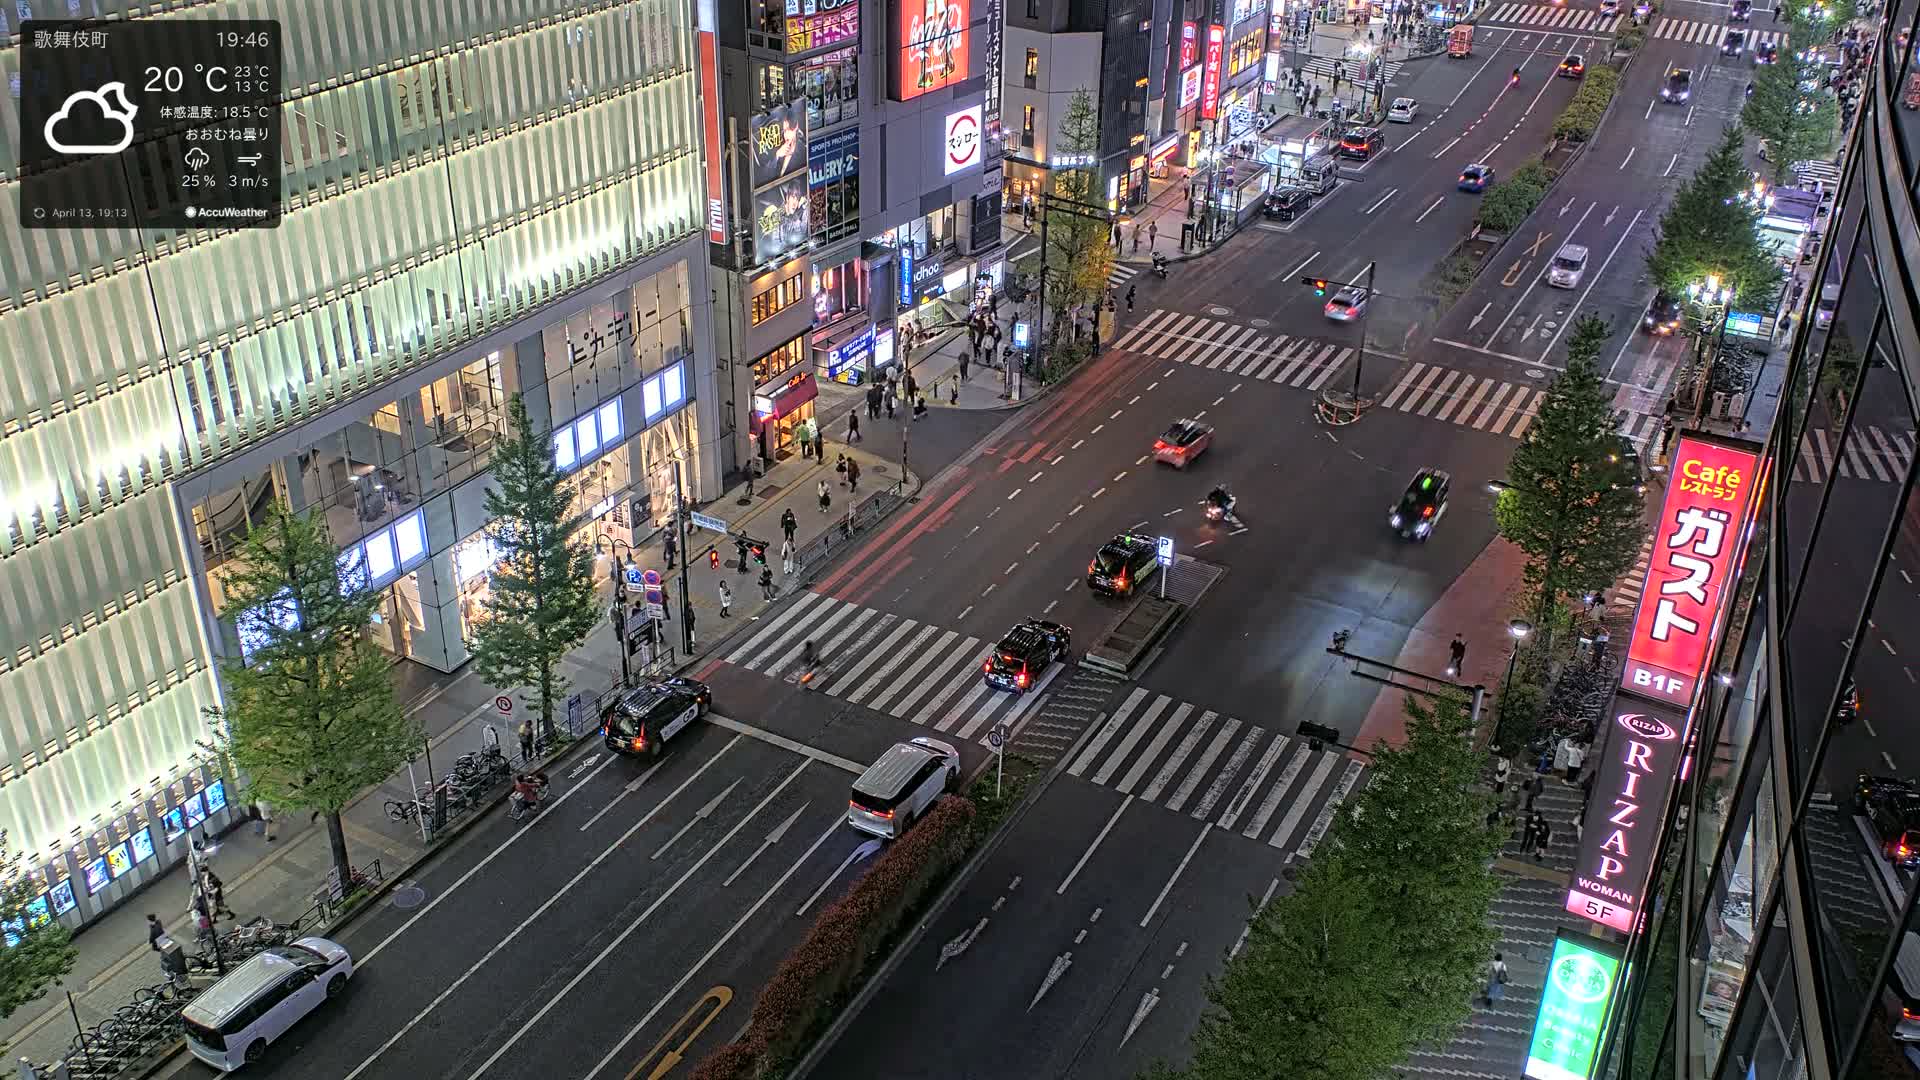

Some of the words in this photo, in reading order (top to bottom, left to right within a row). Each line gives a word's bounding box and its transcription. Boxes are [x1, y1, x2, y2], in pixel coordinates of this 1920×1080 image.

[1206, 45, 1220, 110] バーガーキング
[949, 132, 979, 150] スシロー
[710, 198, 723, 233] MUJI
[572, 309, 657, 369] ピカデリー
[1683, 460, 1741, 489] Café
[1680, 479, 1736, 501] レストラン
[1650, 507, 1730, 642] ガスト
[1633, 669, 1684, 695] B1F
[1632, 718, 1664, 735] RIZAP
[1596, 740, 1653, 881] RIZAP
[1578, 877, 1634, 904] WOMAN
[1586, 901, 1614, 921] 5F
